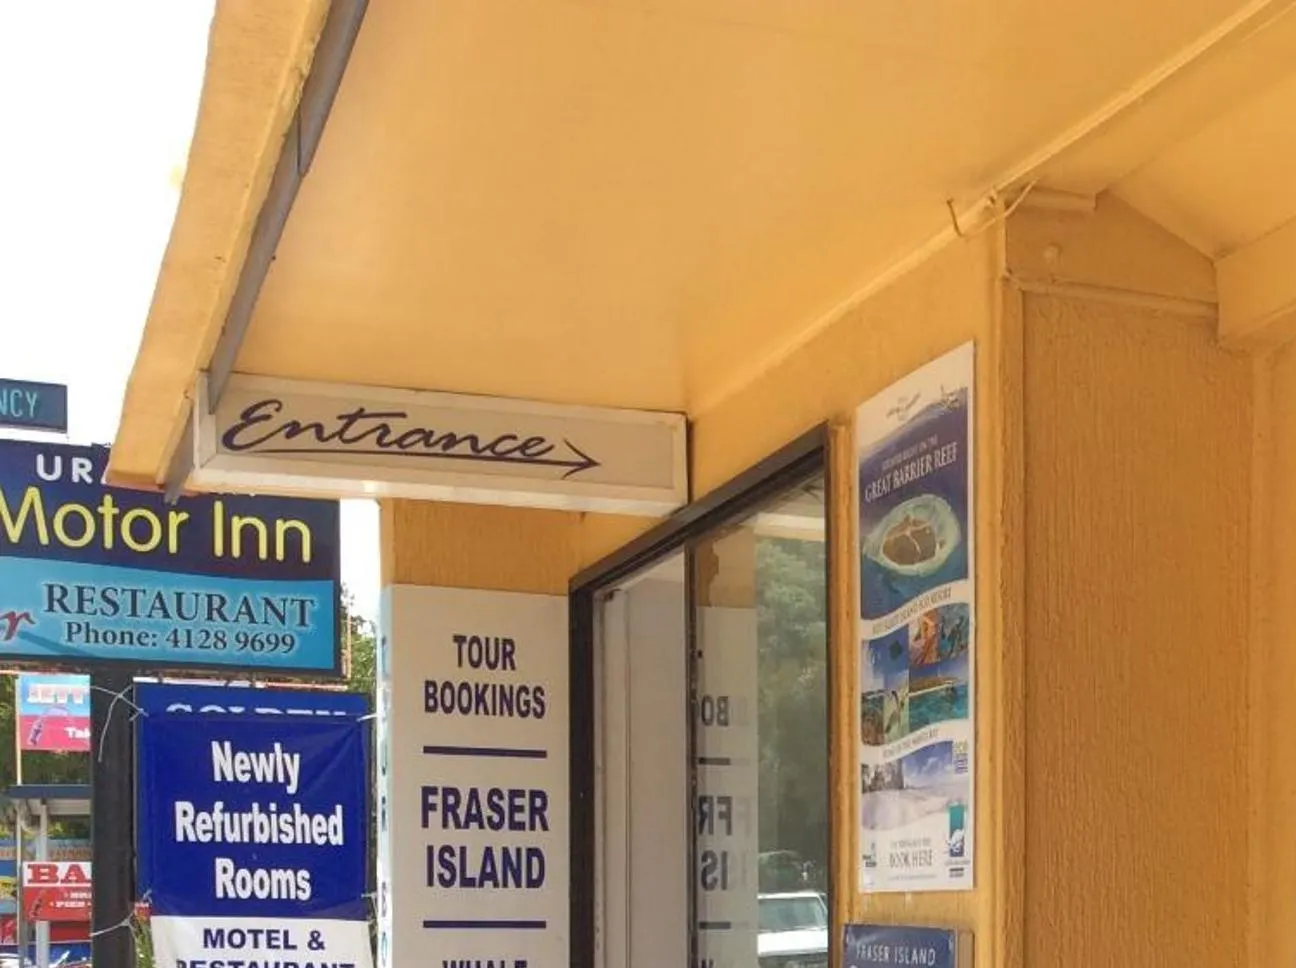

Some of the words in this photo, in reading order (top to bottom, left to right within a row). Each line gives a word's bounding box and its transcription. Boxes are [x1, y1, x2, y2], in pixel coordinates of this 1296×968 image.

[222, 399, 555, 457] Entrance
[36, 454, 106, 484] UR
[864, 472, 892, 503] GREAT
[892, 452, 933, 490] BARRIER
[934, 441, 958, 470] REEF
[0, 485, 190, 555] Motor
[213, 499, 312, 563] Inn
[42, 582, 316, 628] RESTAURANT
[64, 621, 158, 647] Phone:
[165, 627, 228, 651] 4128
[234, 631, 296, 655] 9699
[452, 634, 517, 672] TOUR
[423, 680, 546, 719] BOOKINGS
[211, 740, 301, 794] Newly
[174, 800, 345, 847] Refurbished
[420, 785, 550, 832] FRASER
[214, 856, 313, 901] Rooms
[426, 844, 546, 890] ISLAND
[202, 928, 298, 951] MOTEL
[306, 929, 326, 951] &
[857, 944, 889, 963] FRASER
[894, 946, 936, 967] ISLAND
